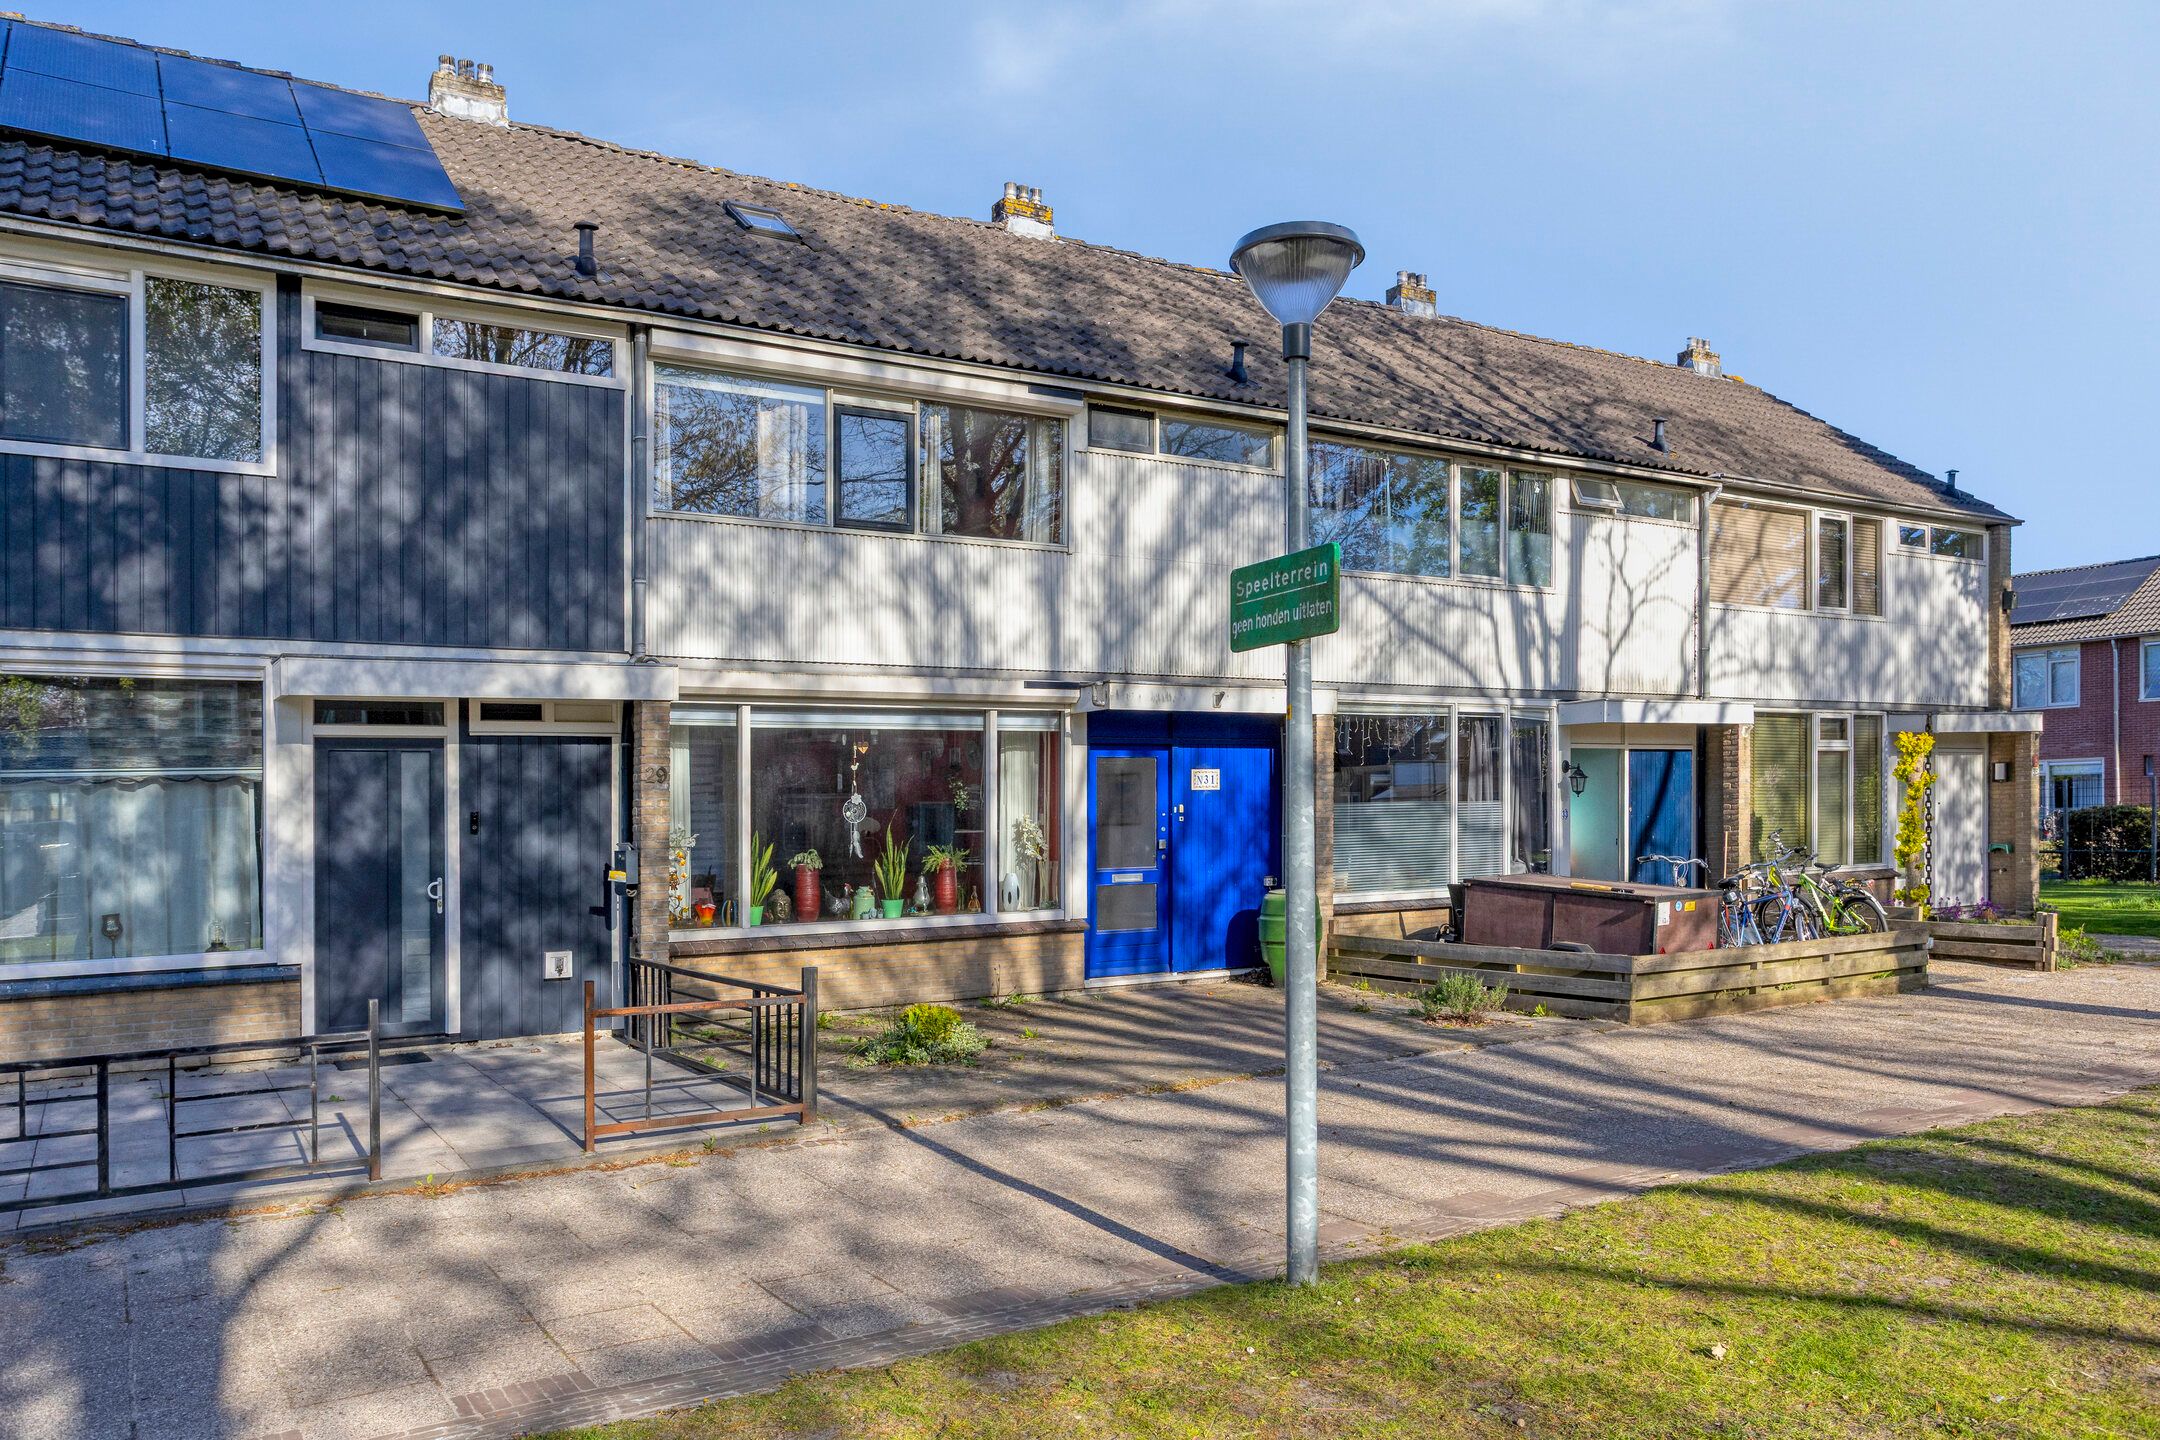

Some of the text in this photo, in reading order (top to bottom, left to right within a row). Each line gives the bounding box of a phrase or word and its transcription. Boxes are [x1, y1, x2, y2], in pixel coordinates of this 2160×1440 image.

[1236, 561, 1328, 598] Speelterrein
[1232, 600, 1332, 639] geen honden uitlaten
[645, 766, 668, 784] 29
[1197, 774, 1215, 785] N31
